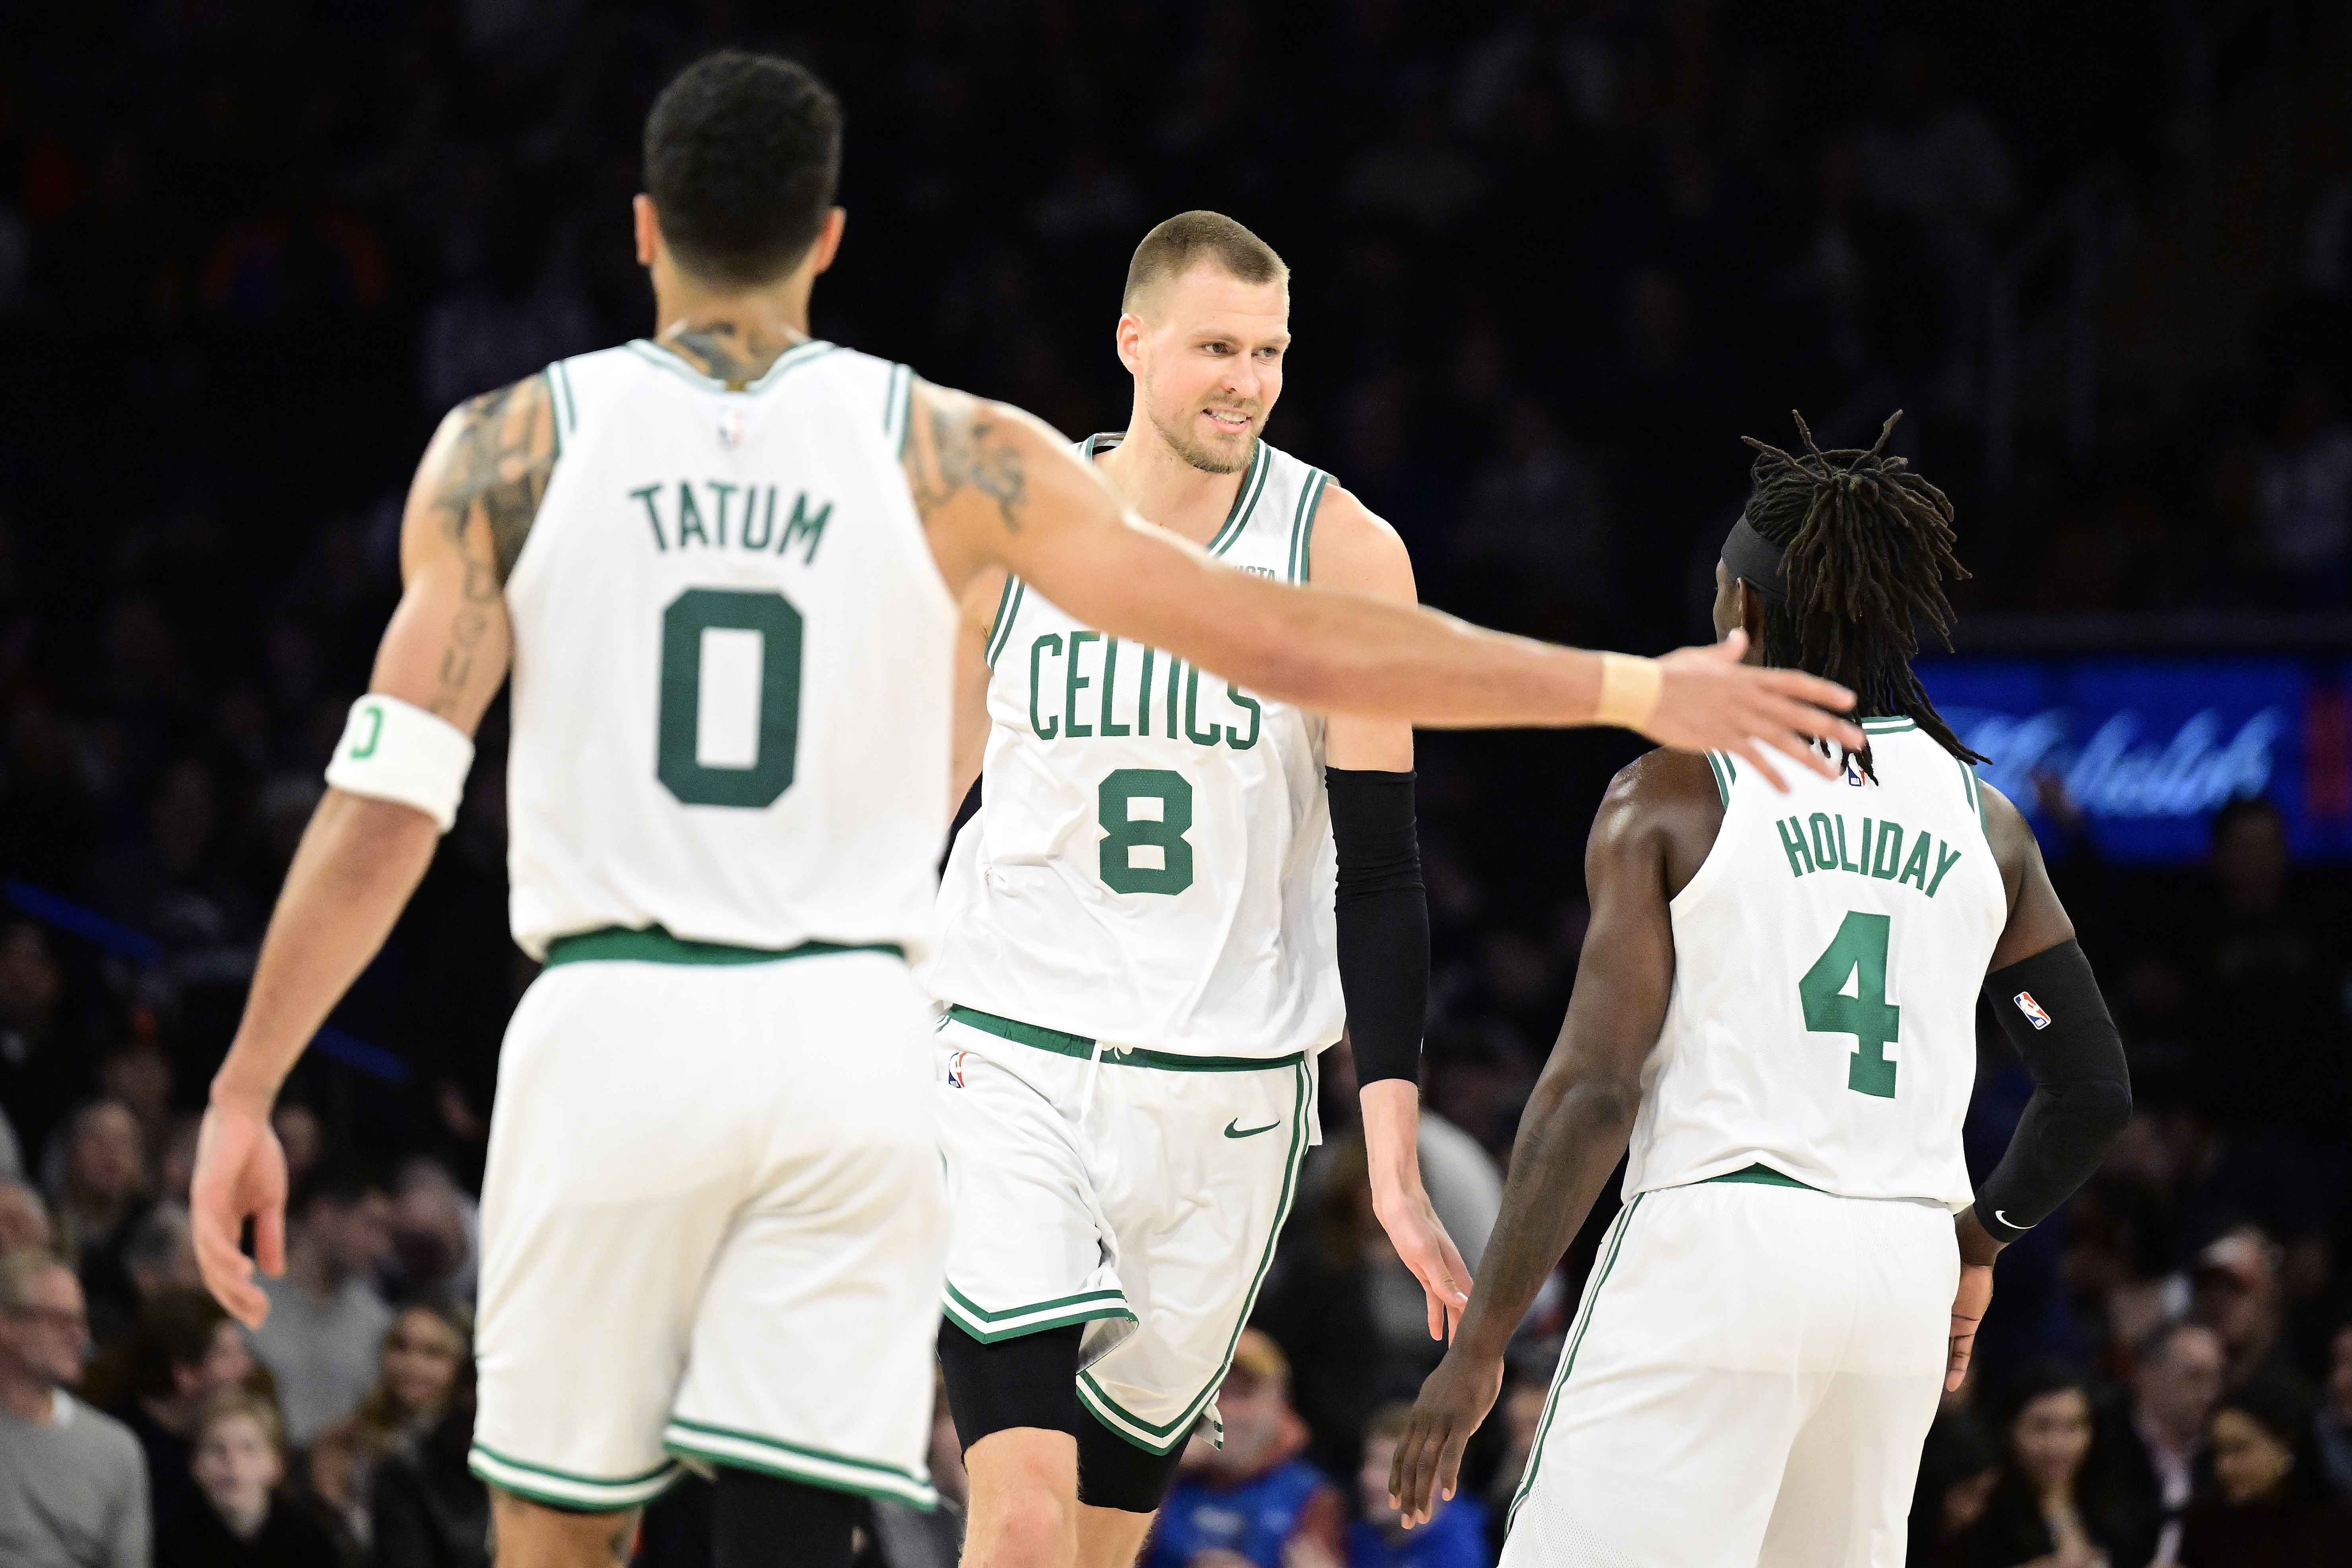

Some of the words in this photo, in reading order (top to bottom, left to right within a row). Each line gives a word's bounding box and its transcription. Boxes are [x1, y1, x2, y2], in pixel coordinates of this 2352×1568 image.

[629, 479, 834, 567] TATUM
[657, 586, 805, 809] 0
[1030, 631, 1261, 750] CELTICS
[1098, 768, 1193, 895] 8
[1776, 812, 1962, 898] HOLIDAY
[1799, 910, 1900, 1099] 4
